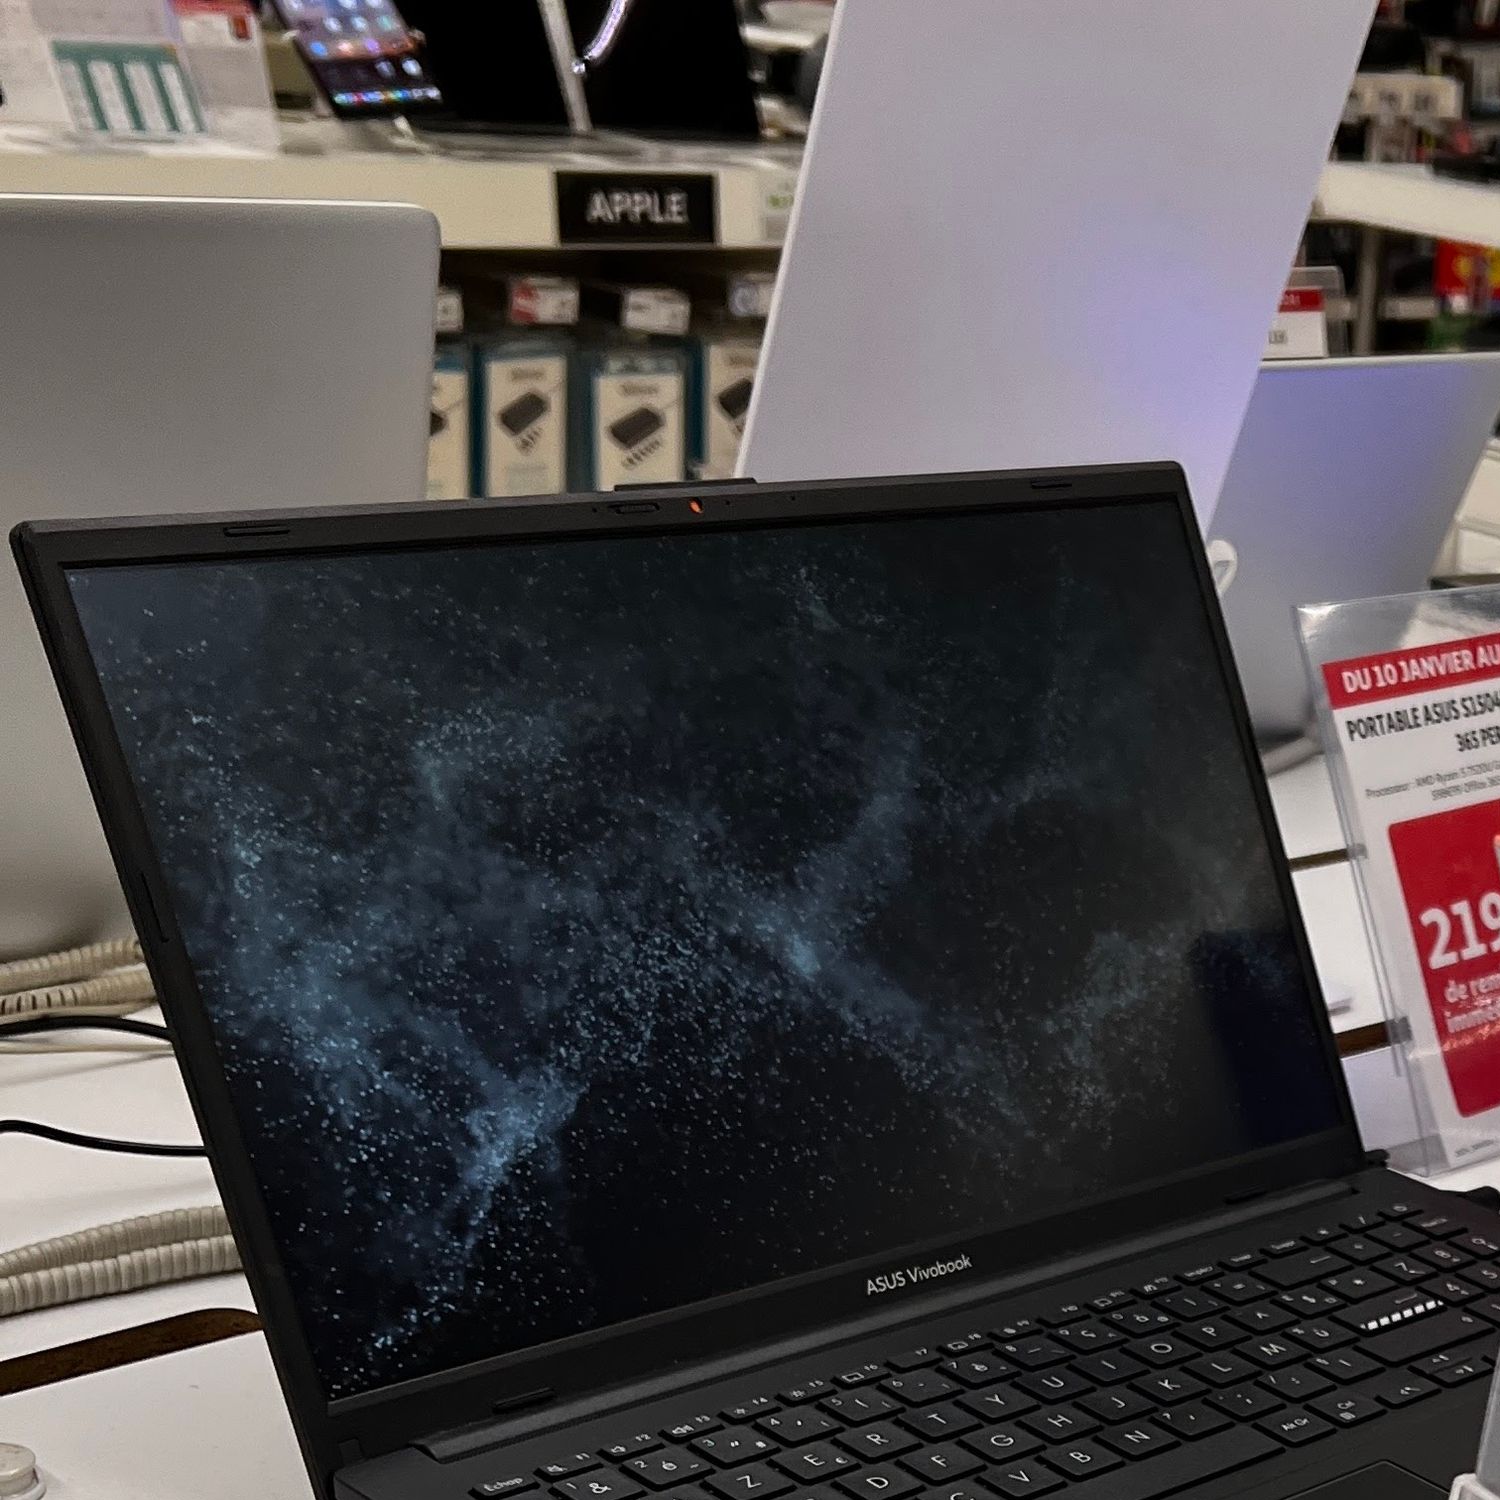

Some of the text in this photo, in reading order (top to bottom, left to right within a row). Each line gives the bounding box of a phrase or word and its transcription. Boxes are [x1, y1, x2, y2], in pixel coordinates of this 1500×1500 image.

[586, 187, 689, 224] APPLE
[1341, 668, 1372, 694] DU
[1372, 662, 1399, 688] 10
[1398, 649, 1477, 683] JANVIER
[1345, 706, 1422, 742] PORTABLE
[1423, 699, 1461, 727] ASUS
[866, 1253, 973, 1296] ASUS Vivobook
